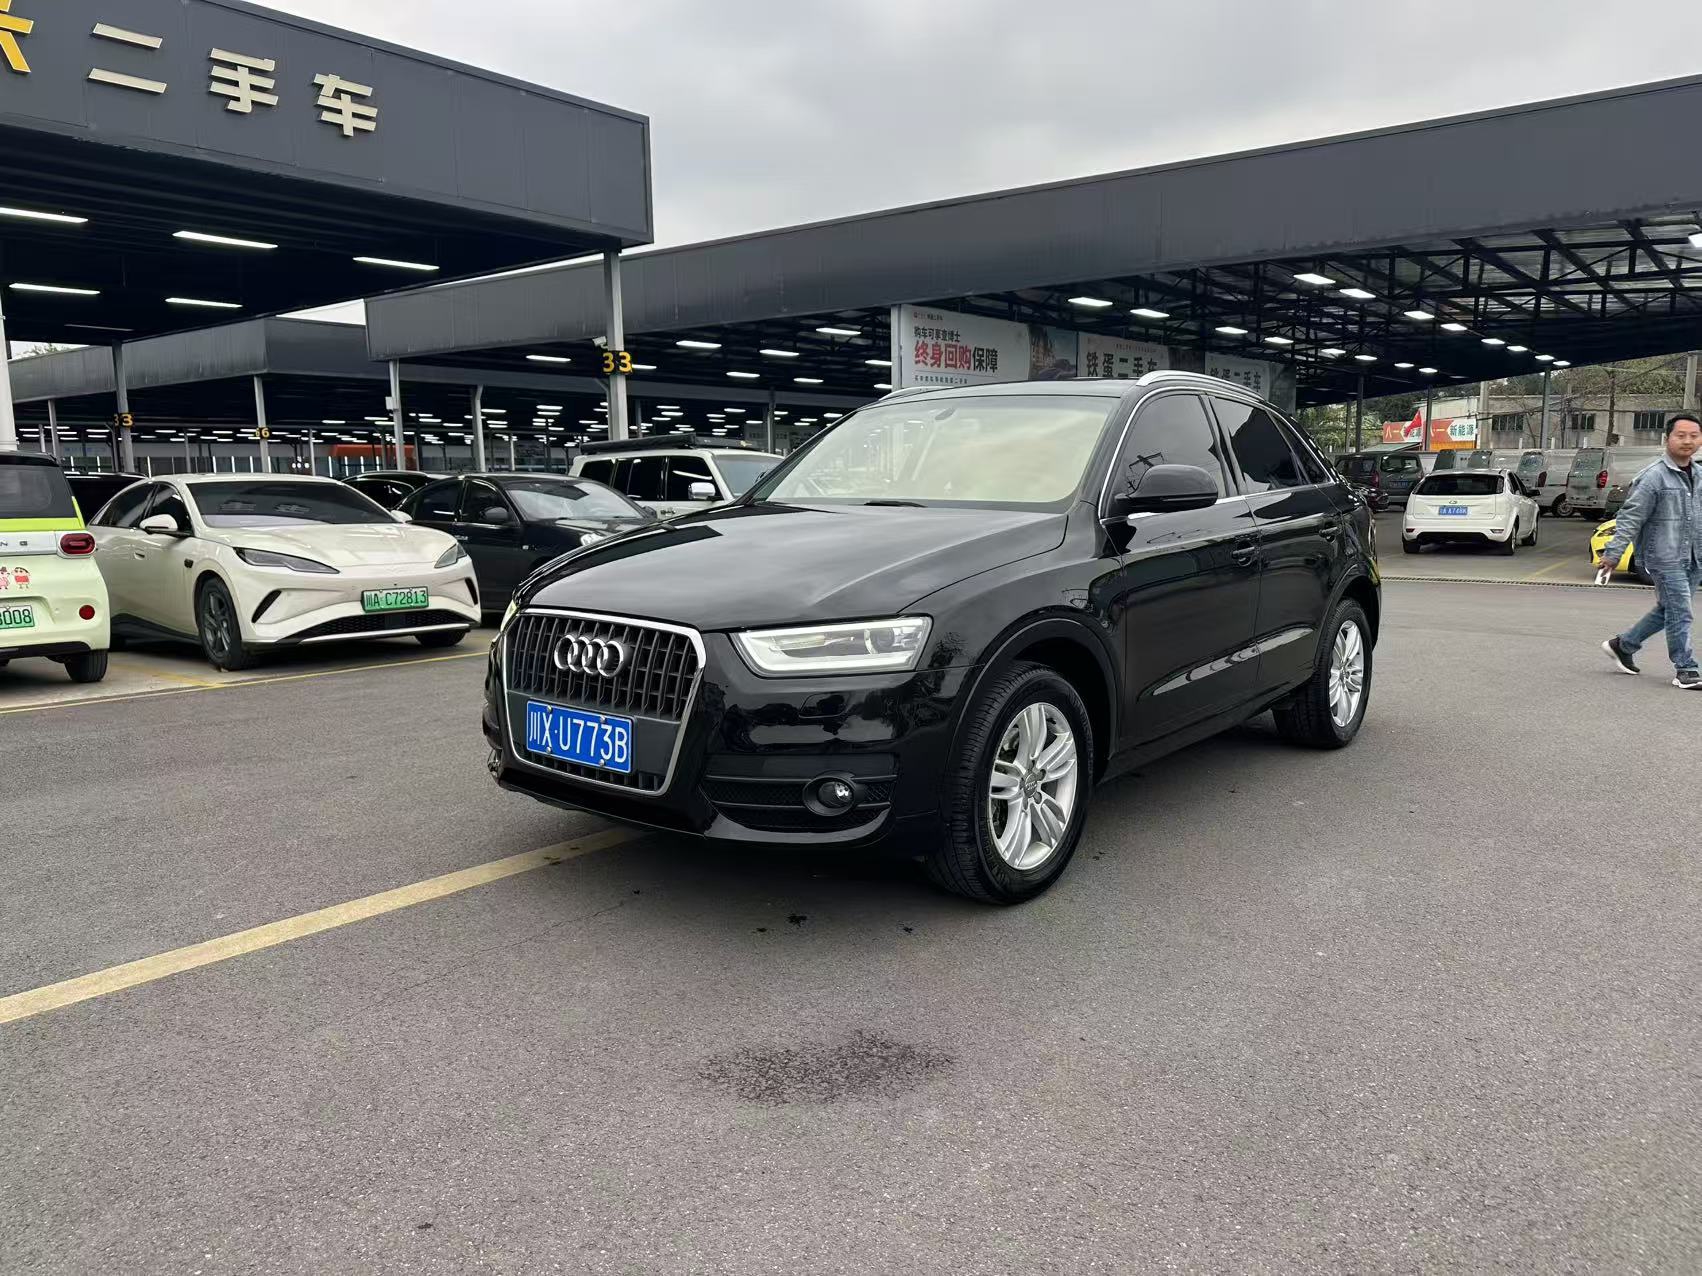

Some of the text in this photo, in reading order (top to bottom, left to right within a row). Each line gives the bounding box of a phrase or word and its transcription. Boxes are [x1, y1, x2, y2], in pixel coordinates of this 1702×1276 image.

[88, 21, 378, 137] 二手车
[914, 340, 998, 373] 终身回购保障
[1450, 424, 1474, 437] 新能源
